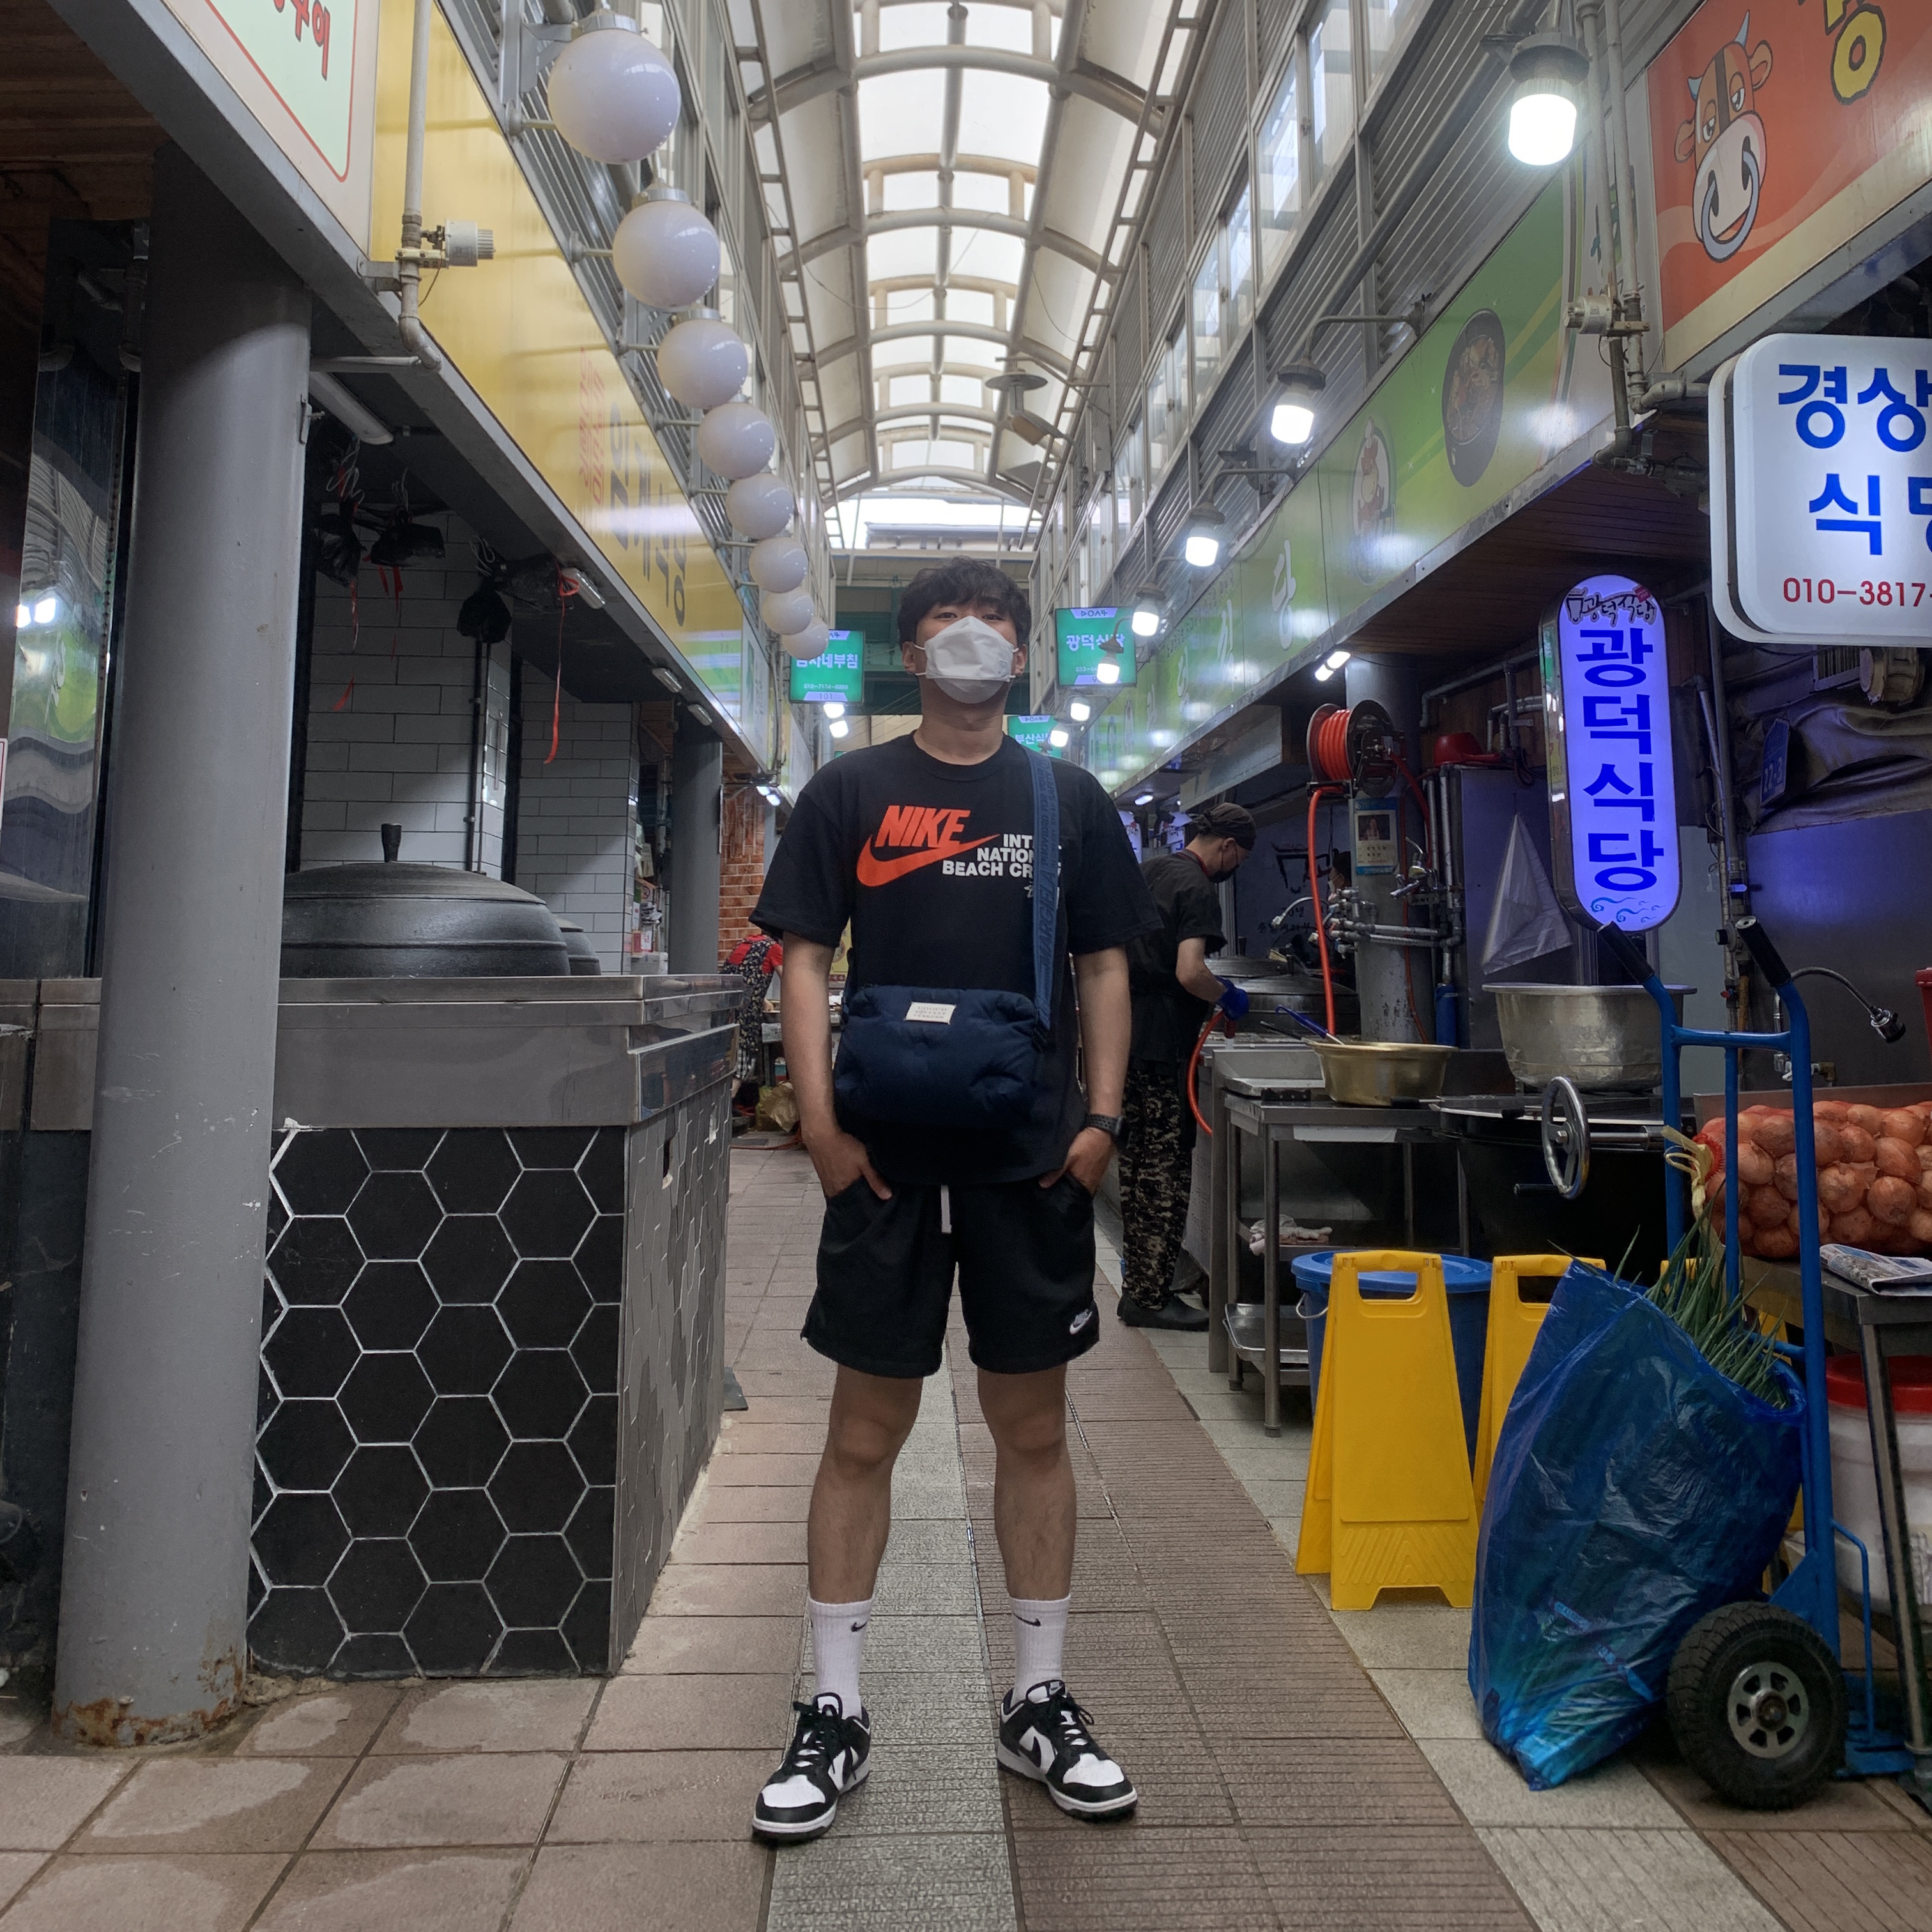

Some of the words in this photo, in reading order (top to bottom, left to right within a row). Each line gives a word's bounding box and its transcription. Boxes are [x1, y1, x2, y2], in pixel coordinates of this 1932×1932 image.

[1783, 578, 1932, 607] 010-3817
[1581, 594, 1656, 625] 광덕식당
[1575, 627, 1664, 891] 광덕식당
[875, 804, 971, 848] NIKE
[942, 860, 1003, 877] BEACH
